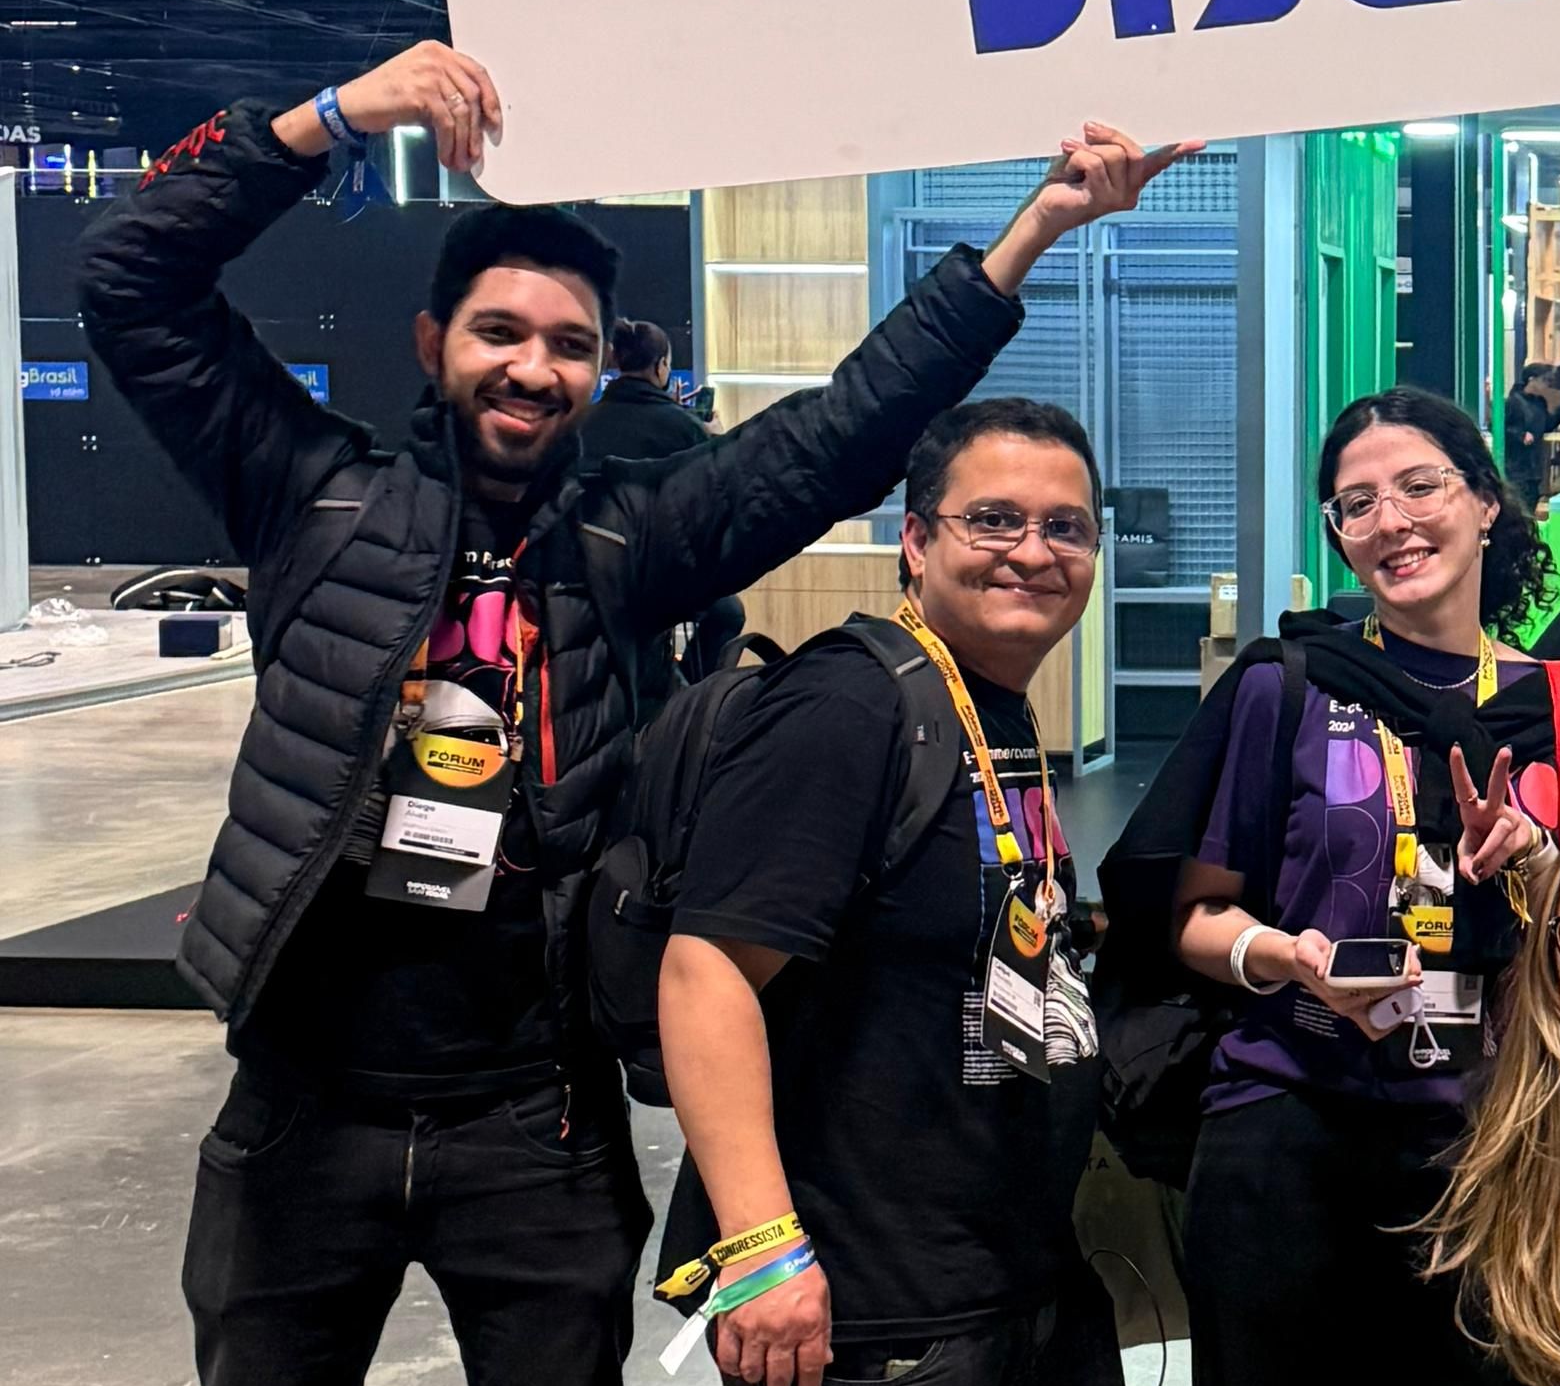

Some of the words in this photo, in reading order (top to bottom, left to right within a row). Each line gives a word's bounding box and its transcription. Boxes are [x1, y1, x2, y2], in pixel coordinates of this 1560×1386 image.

[1328, 720, 1355, 732] 2024
[428, 750, 486, 768] FÓRUM
[716, 1224, 785, 1261] CONGRESSISTA
